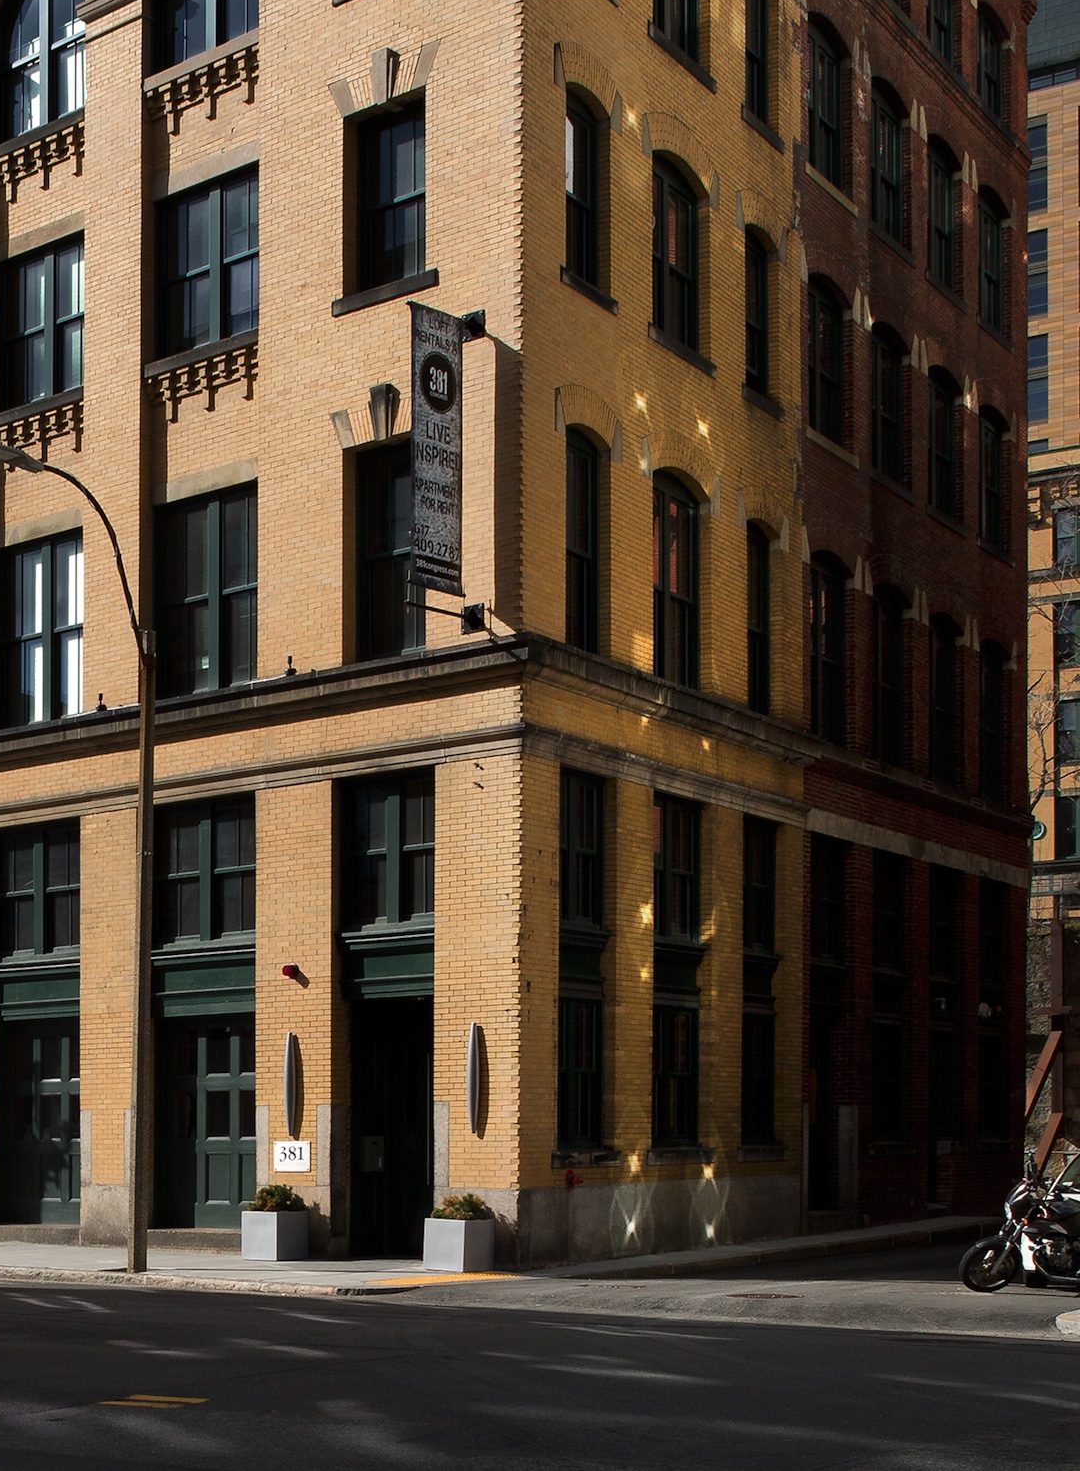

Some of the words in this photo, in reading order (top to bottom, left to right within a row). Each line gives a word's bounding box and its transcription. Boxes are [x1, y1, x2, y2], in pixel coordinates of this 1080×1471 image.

[429, 366, 448, 395] 381
[426, 420, 451, 445] LIVE
[414, 440, 461, 471] NSPIRED
[421, 495, 435, 513] FOR
[436, 500, 455, 517] RENT
[279, 1146, 305, 1163] 381
